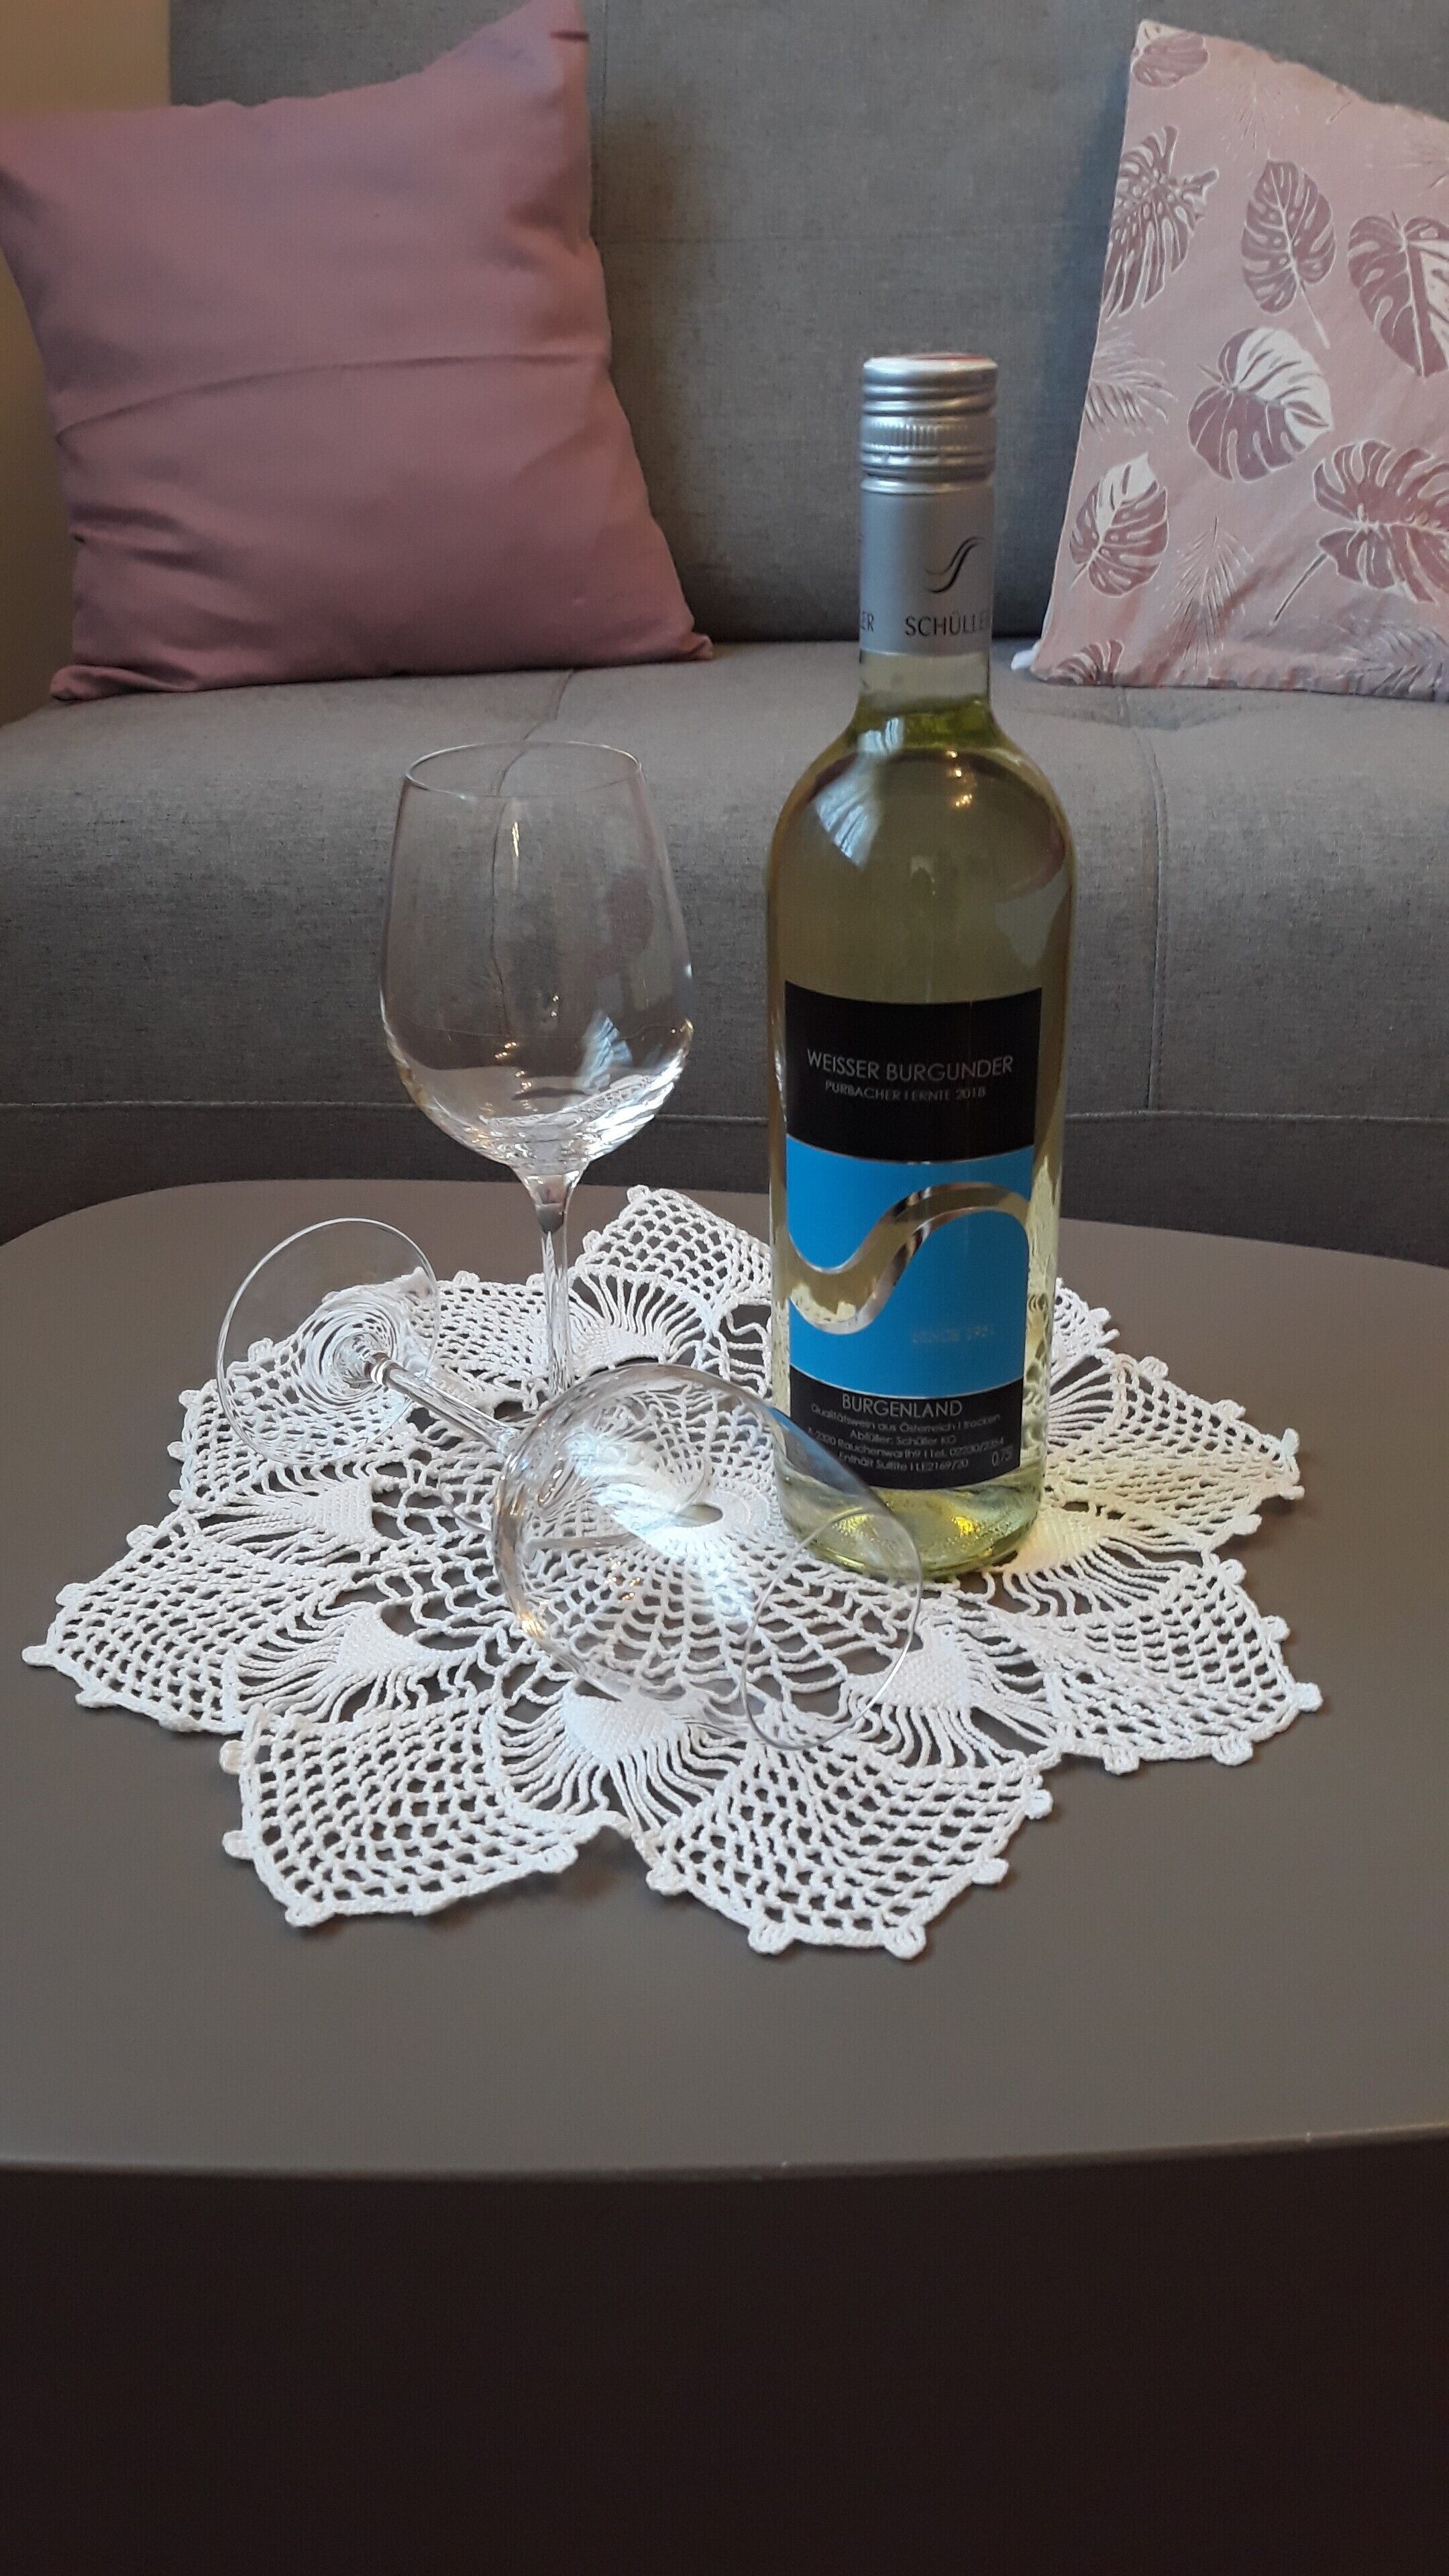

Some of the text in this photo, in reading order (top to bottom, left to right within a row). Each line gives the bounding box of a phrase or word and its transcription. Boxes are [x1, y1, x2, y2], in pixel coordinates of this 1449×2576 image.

[807, 1048, 1013, 1082] WEISSER BURGUNDER
[825, 1079, 900, 1101] PURBACHER
[842, 1393, 963, 1417] BURGENLAND
